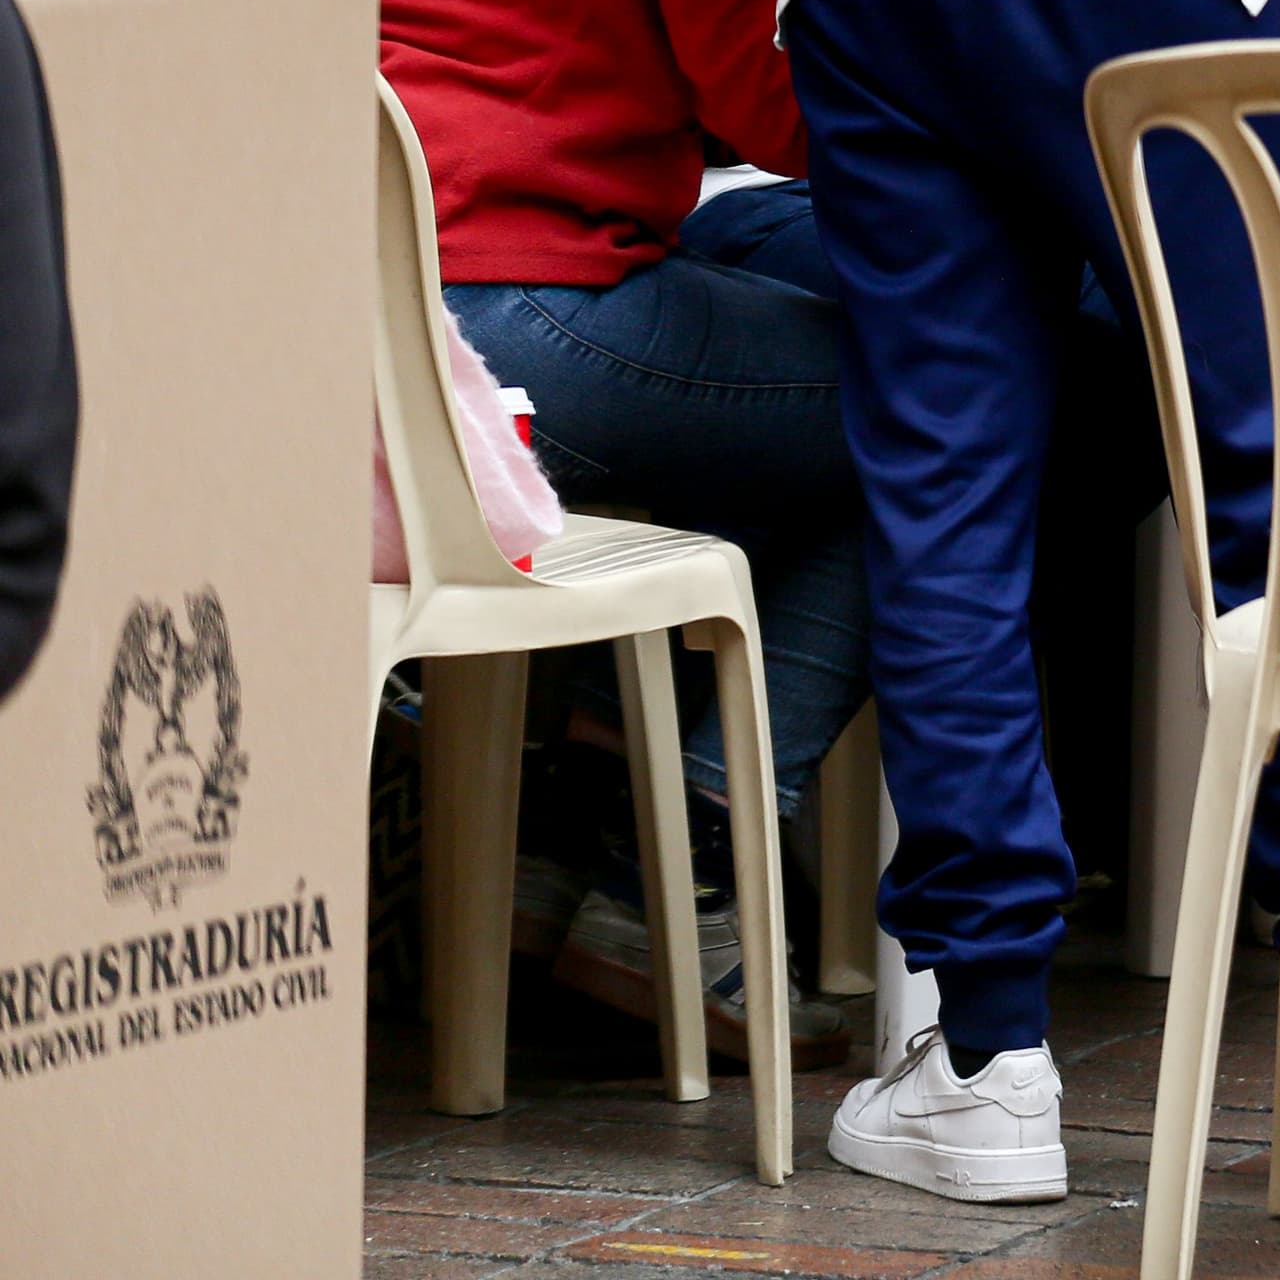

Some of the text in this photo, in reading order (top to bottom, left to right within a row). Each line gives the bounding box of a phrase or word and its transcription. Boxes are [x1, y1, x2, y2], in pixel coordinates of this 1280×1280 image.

[0, 875, 332, 1032] REGISTRADURÍA
[119, 1004, 163, 1050] DEL
[173, 982, 266, 1035] ESTADO
[272, 965, 331, 1010] CIVIL
